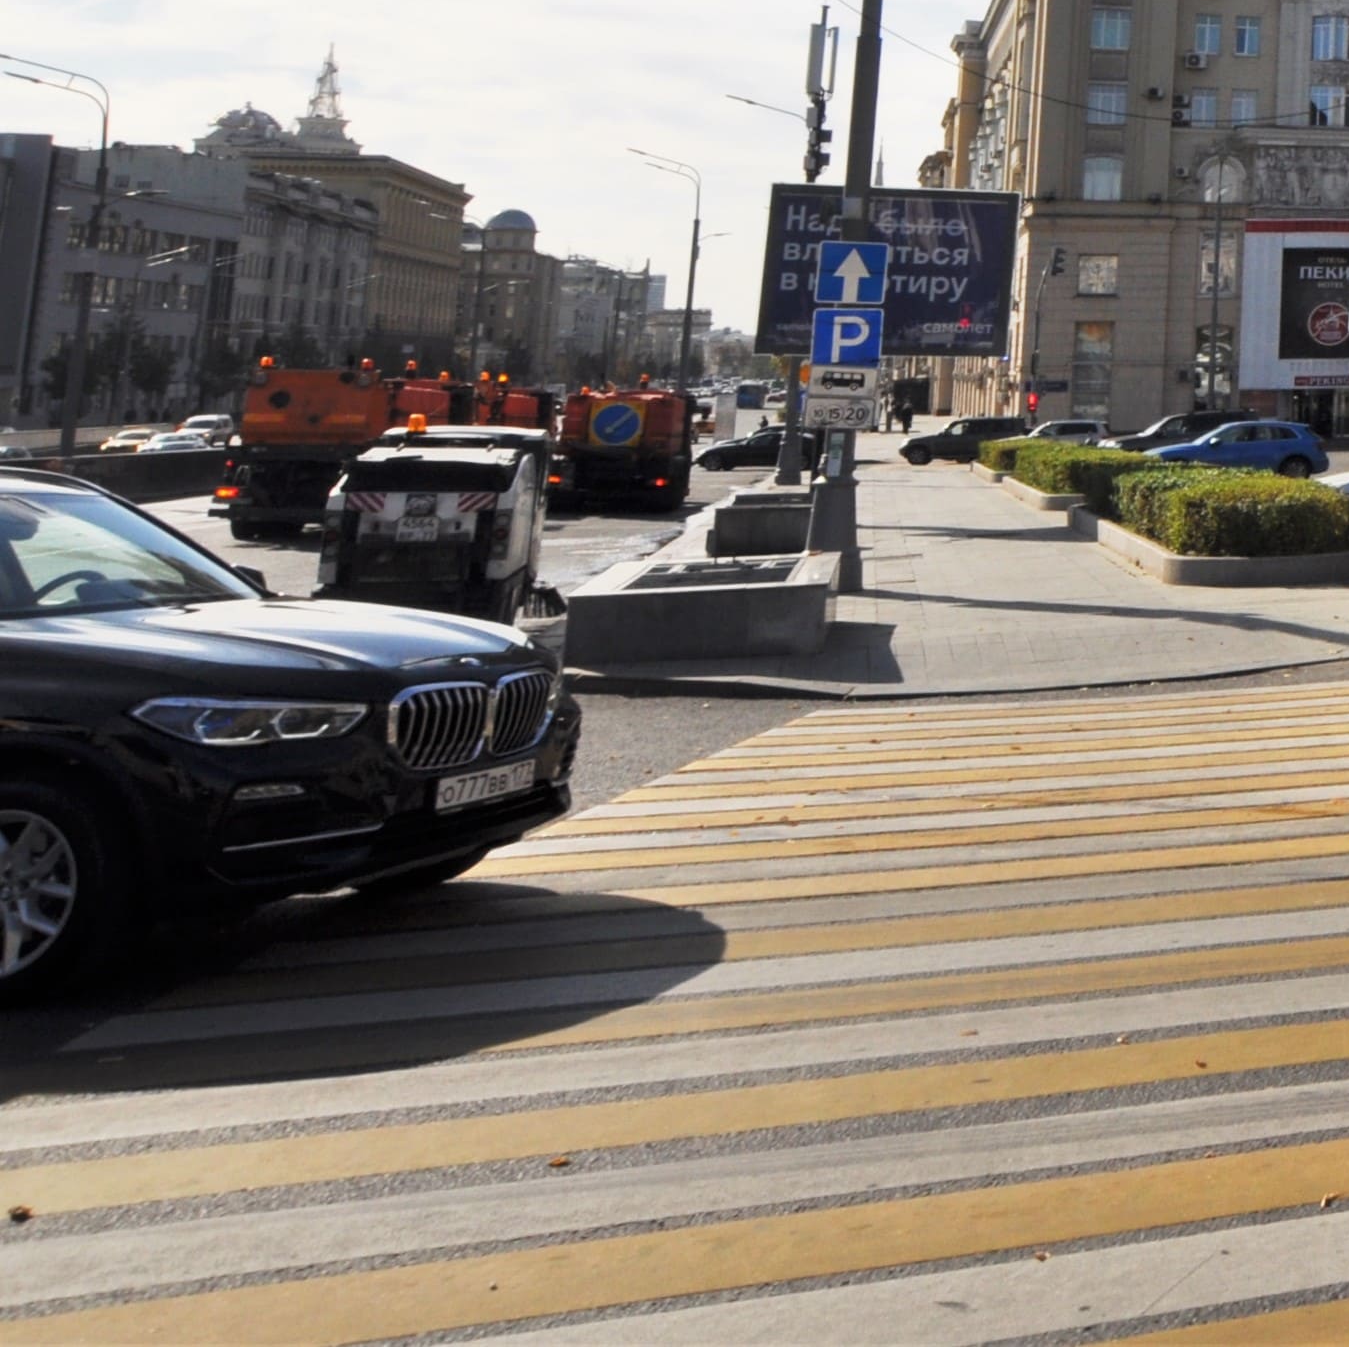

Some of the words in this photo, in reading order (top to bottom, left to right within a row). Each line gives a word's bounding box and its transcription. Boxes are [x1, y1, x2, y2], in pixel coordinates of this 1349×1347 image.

[786, 205, 843, 236] Над
[877, 209, 967, 237] было
[783, 243, 969, 266] влться
[780, 272, 798, 291] в
[831, 316, 870, 364] P
[846, 408, 865, 420] 20
